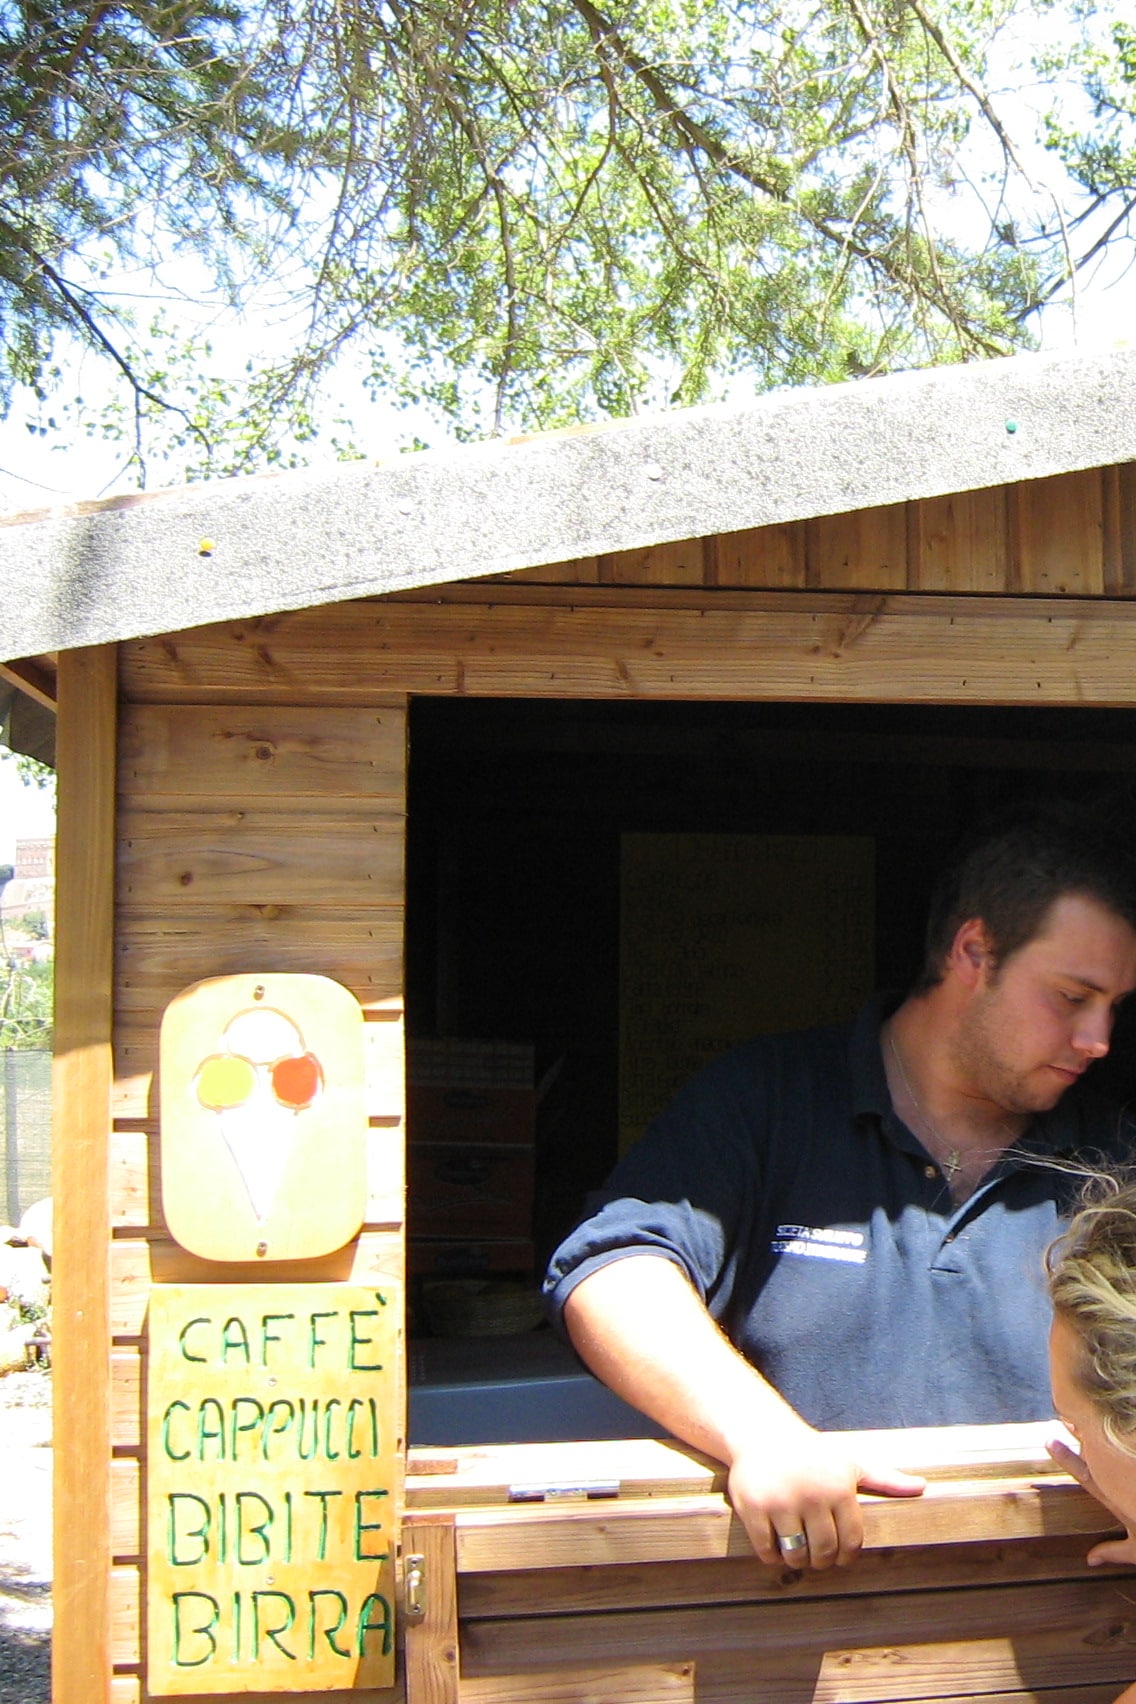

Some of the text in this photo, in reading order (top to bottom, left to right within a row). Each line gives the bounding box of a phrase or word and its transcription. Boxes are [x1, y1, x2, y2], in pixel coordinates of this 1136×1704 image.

[179, 1292, 388, 1371] CAFFÈ
[162, 1397, 378, 1462] CAPPUCCI
[167, 1489, 389, 1567] BIBITE
[170, 1590, 394, 1667] BIRRA
